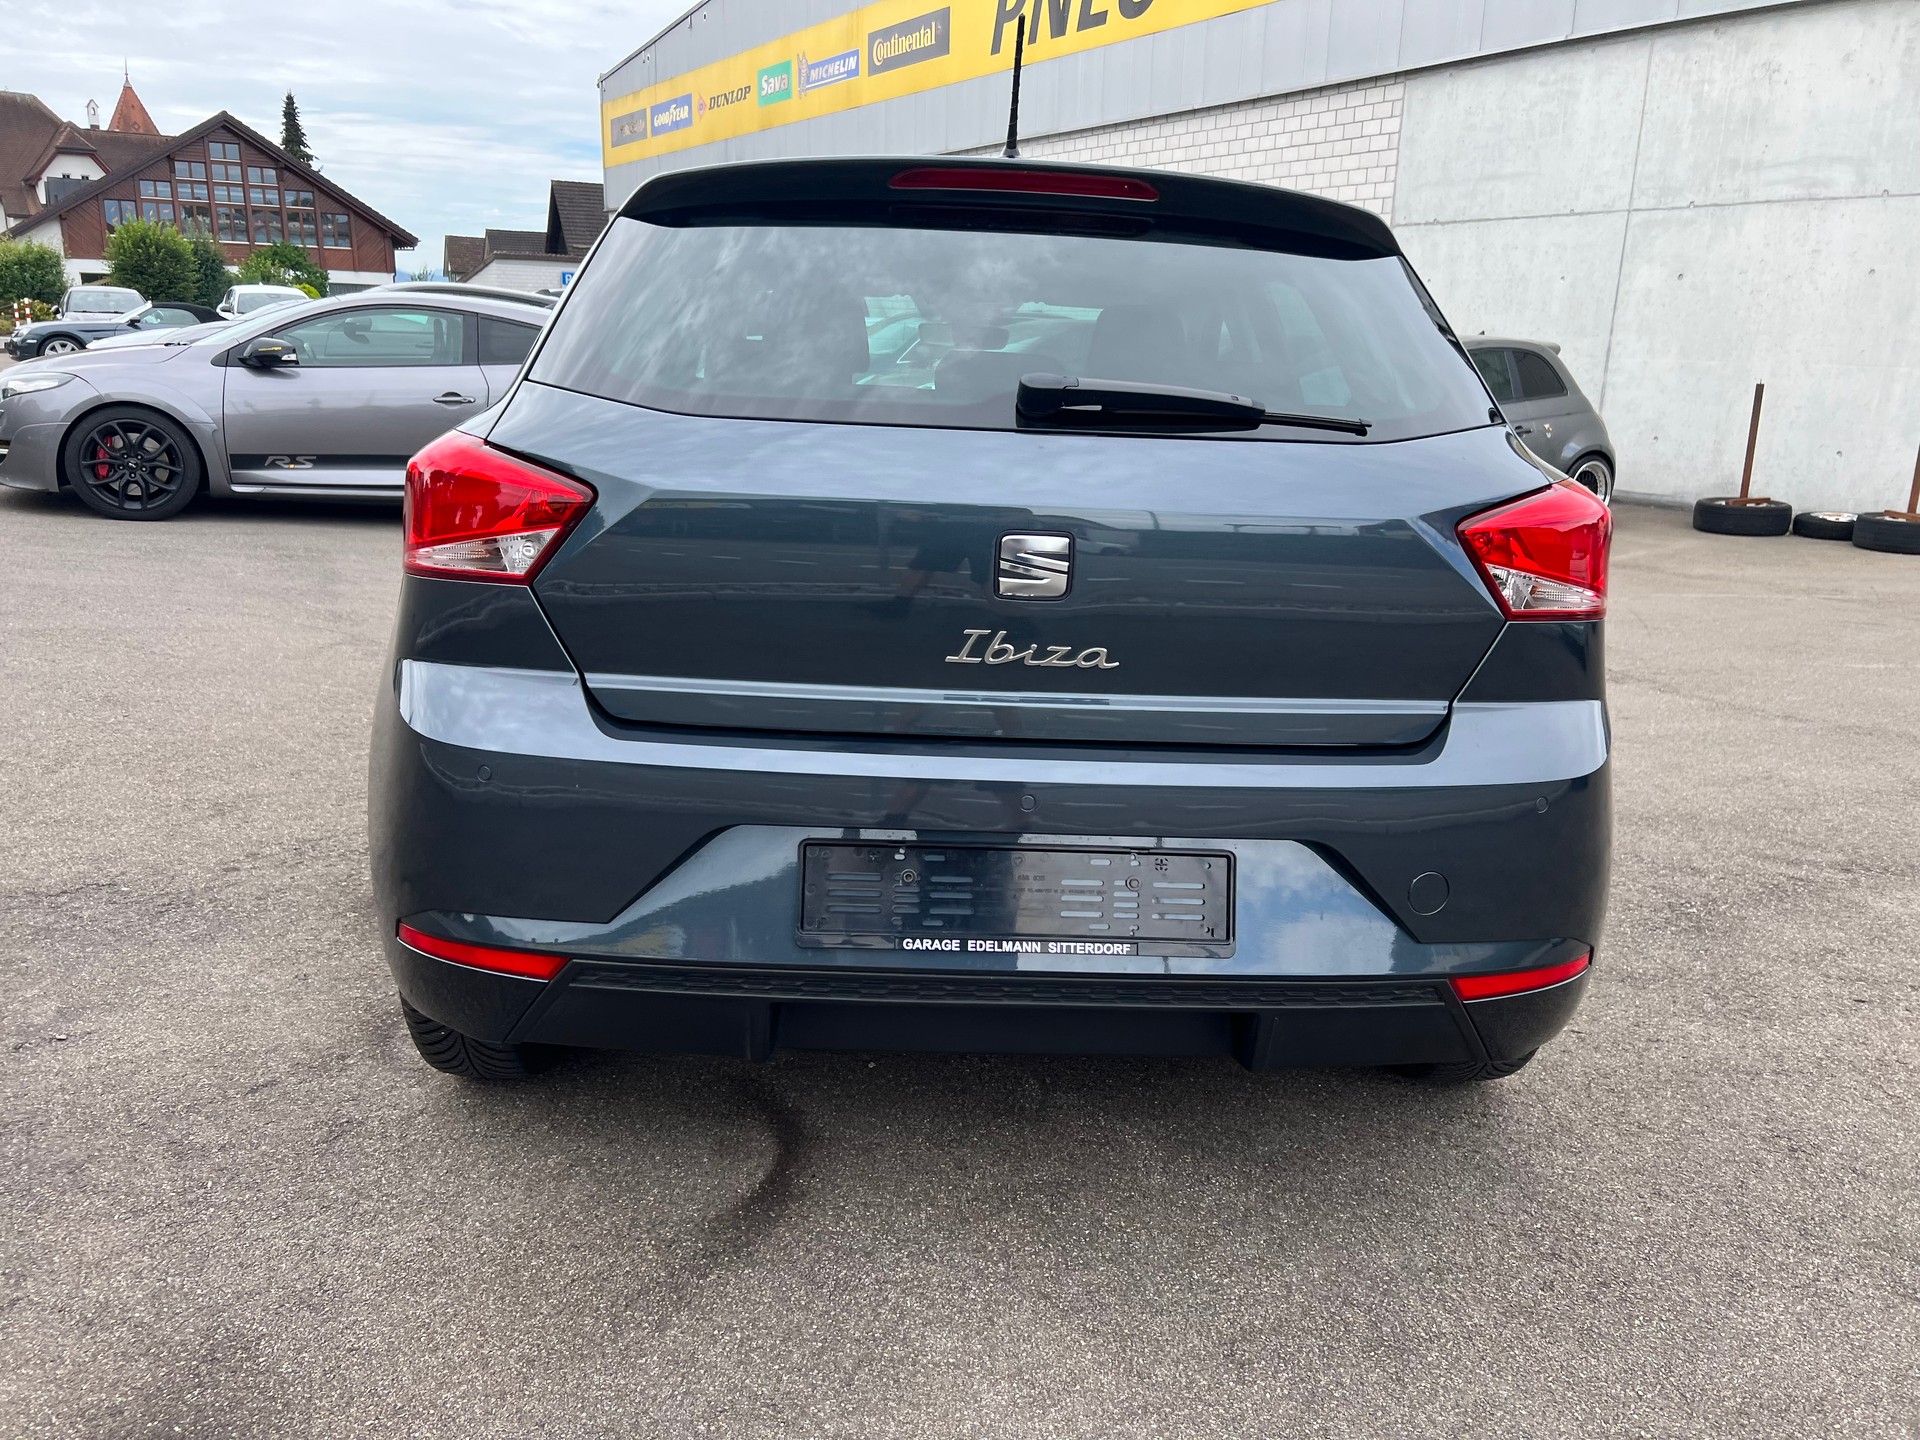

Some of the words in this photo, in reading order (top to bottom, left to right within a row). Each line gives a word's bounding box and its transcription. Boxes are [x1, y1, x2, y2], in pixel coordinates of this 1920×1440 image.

[990, 0, 1153, 56] PN
[873, 21, 936, 66] Continental
[809, 55, 858, 82] MICHELIN
[708, 85, 752, 111] DUNLOP
[761, 74, 789, 97] Sava
[653, 104, 689, 127] GOODYEAR
[944, 629, 1120, 669] Ibiza
[902, 938, 961, 951] GARAGE
[967, 939, 1041, 953] EDELMANN
[1048, 941, 1131, 955] SITTERDORF
